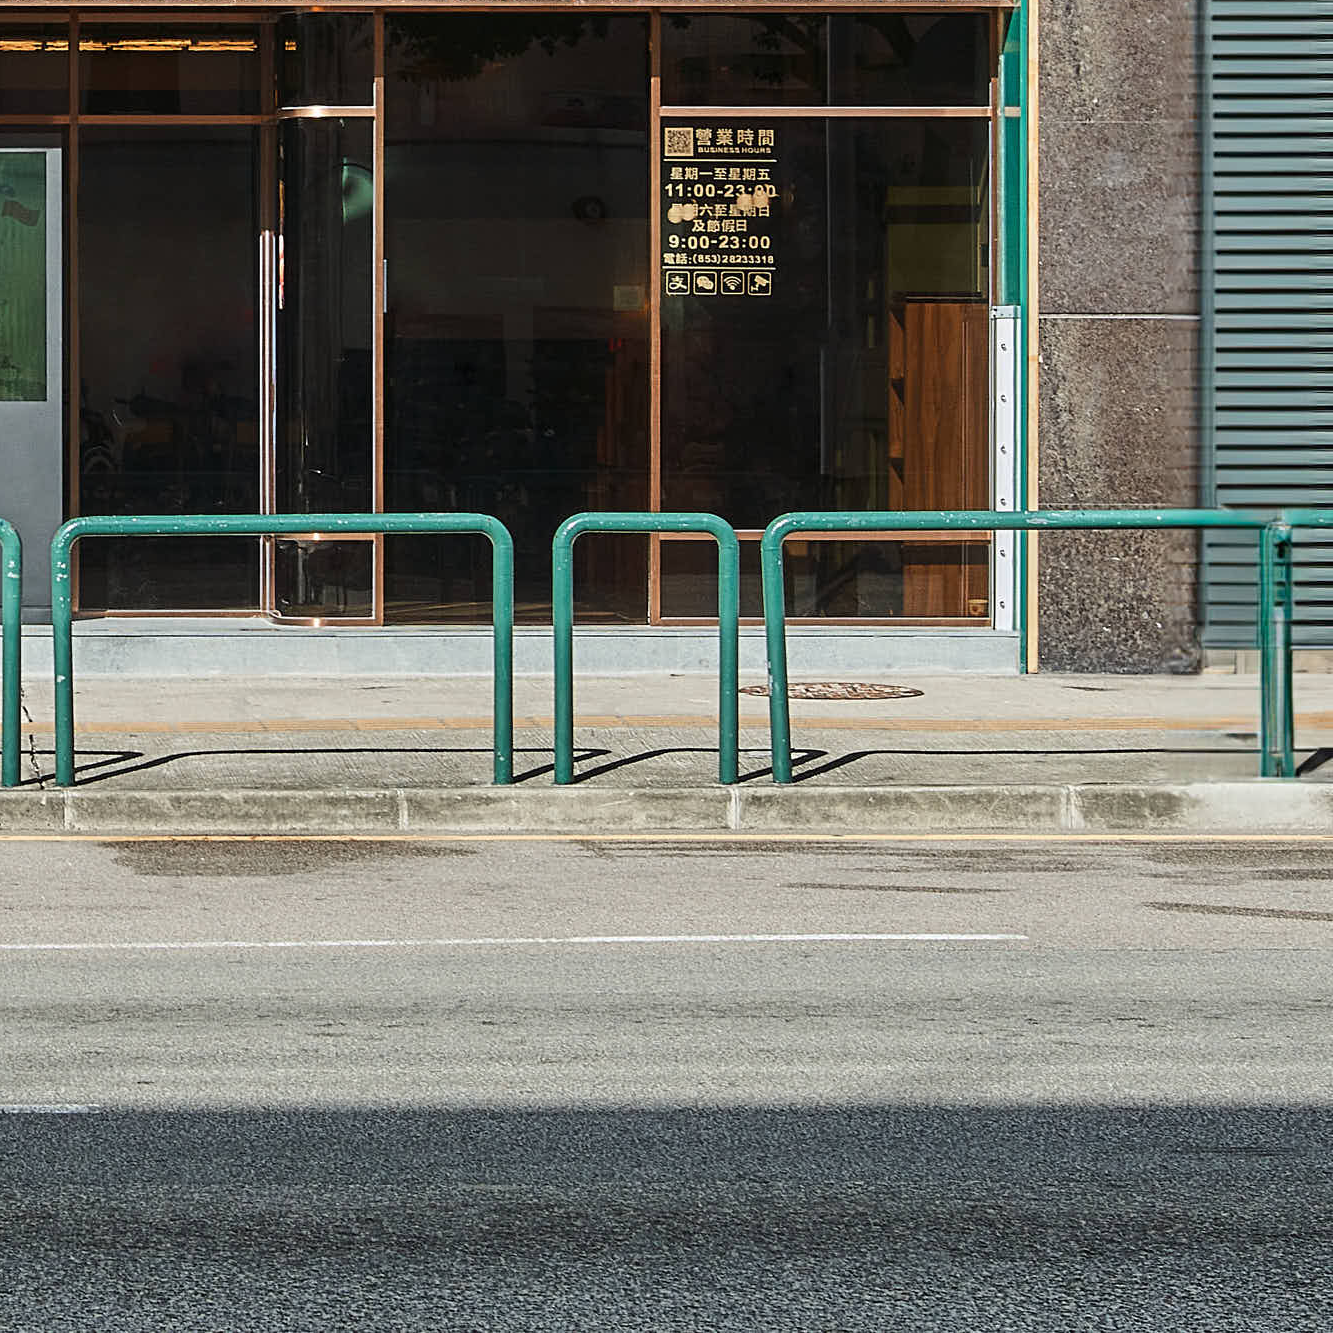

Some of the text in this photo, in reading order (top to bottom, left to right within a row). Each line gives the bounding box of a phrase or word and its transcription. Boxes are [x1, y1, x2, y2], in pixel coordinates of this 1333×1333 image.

[695, 128, 775, 146] 營業時間
[670, 167, 771, 180] 星期一至星期五
[664, 183, 776, 198] 11:00-23:00
[691, 219, 747, 232] 及節假日
[668, 234, 770, 249] 9:00-23:00
